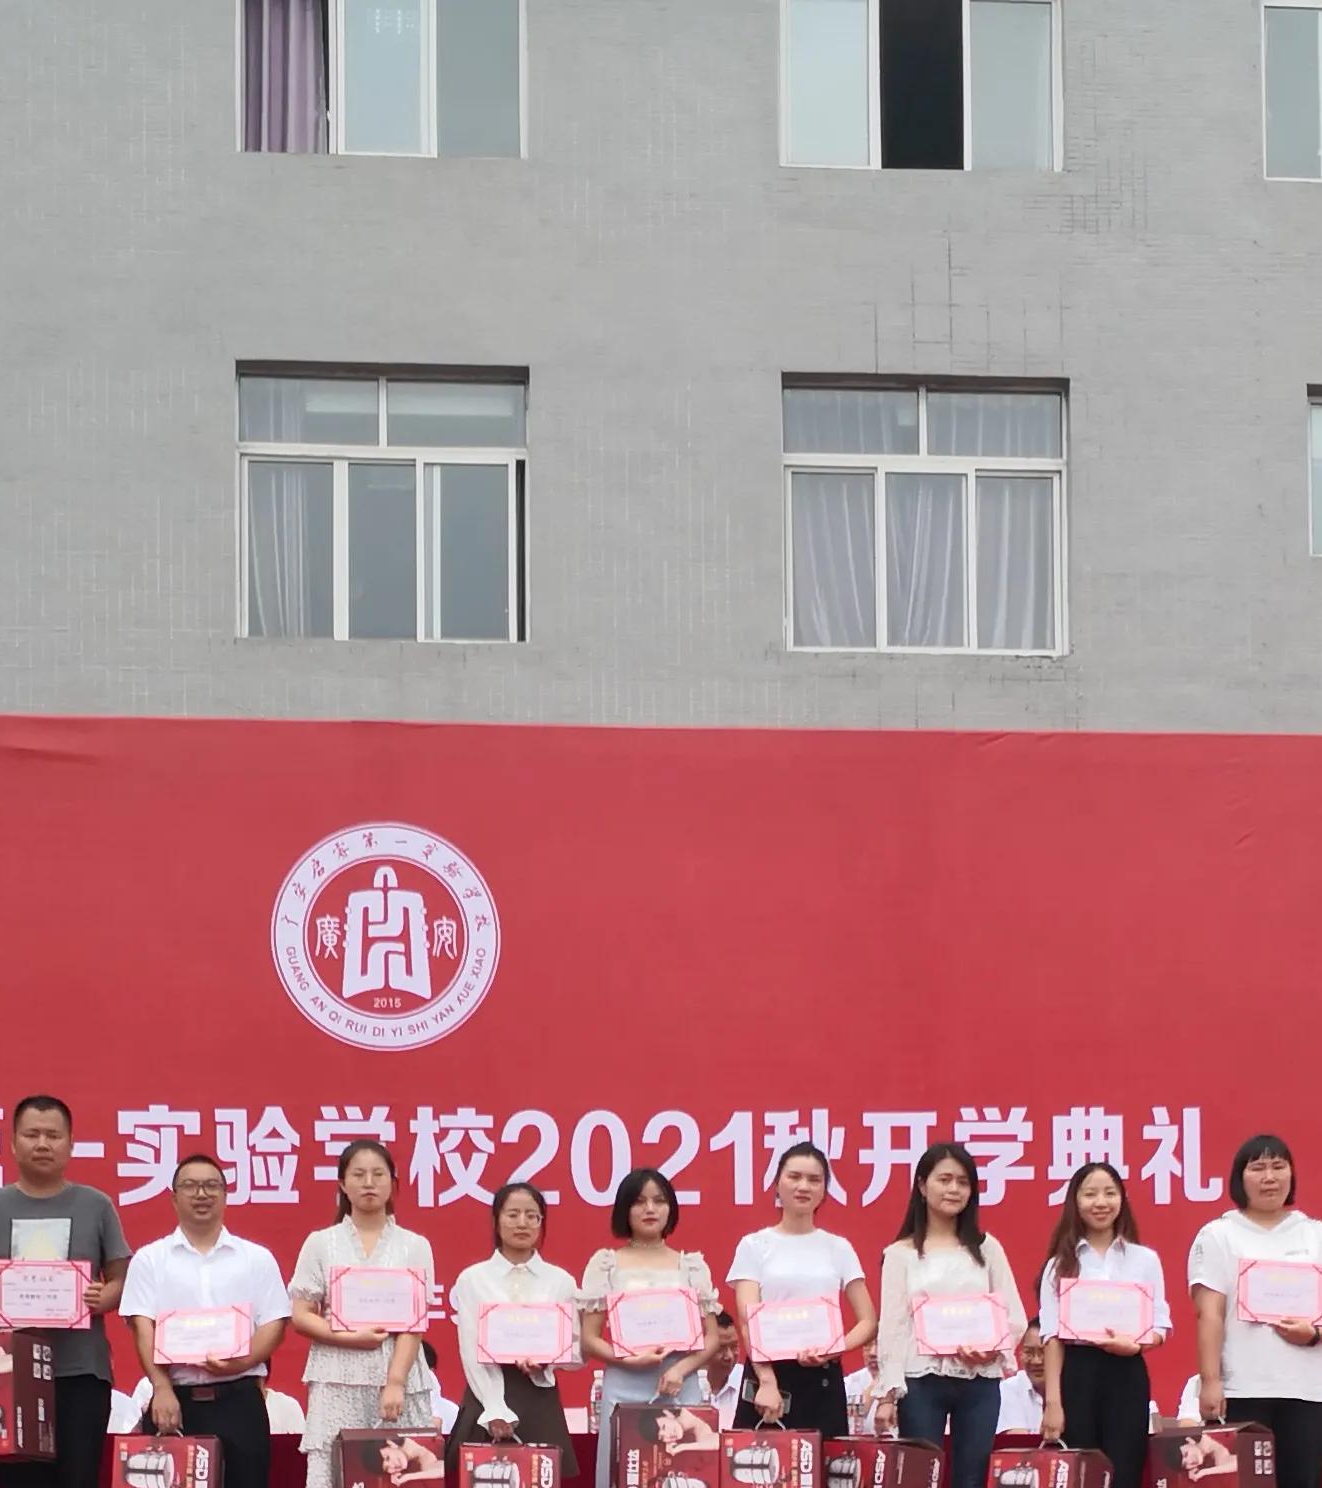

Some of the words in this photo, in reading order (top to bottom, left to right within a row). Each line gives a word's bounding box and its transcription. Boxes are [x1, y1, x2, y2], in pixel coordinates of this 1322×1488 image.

[286, 946, 310, 991] GUANG
[310, 996, 327, 1012] AN
[328, 1010, 342, 1024] QI
[345, 1019, 367, 1034] RUI
[372, 1026, 385, 1037] DI
[391, 1026, 403, 1037] YI
[407, 1020, 429, 1035] SHI
[431, 1004, 455, 1024] YAN
[456, 981, 475, 1006] XUE
[470, 947, 486, 979] XIAO
